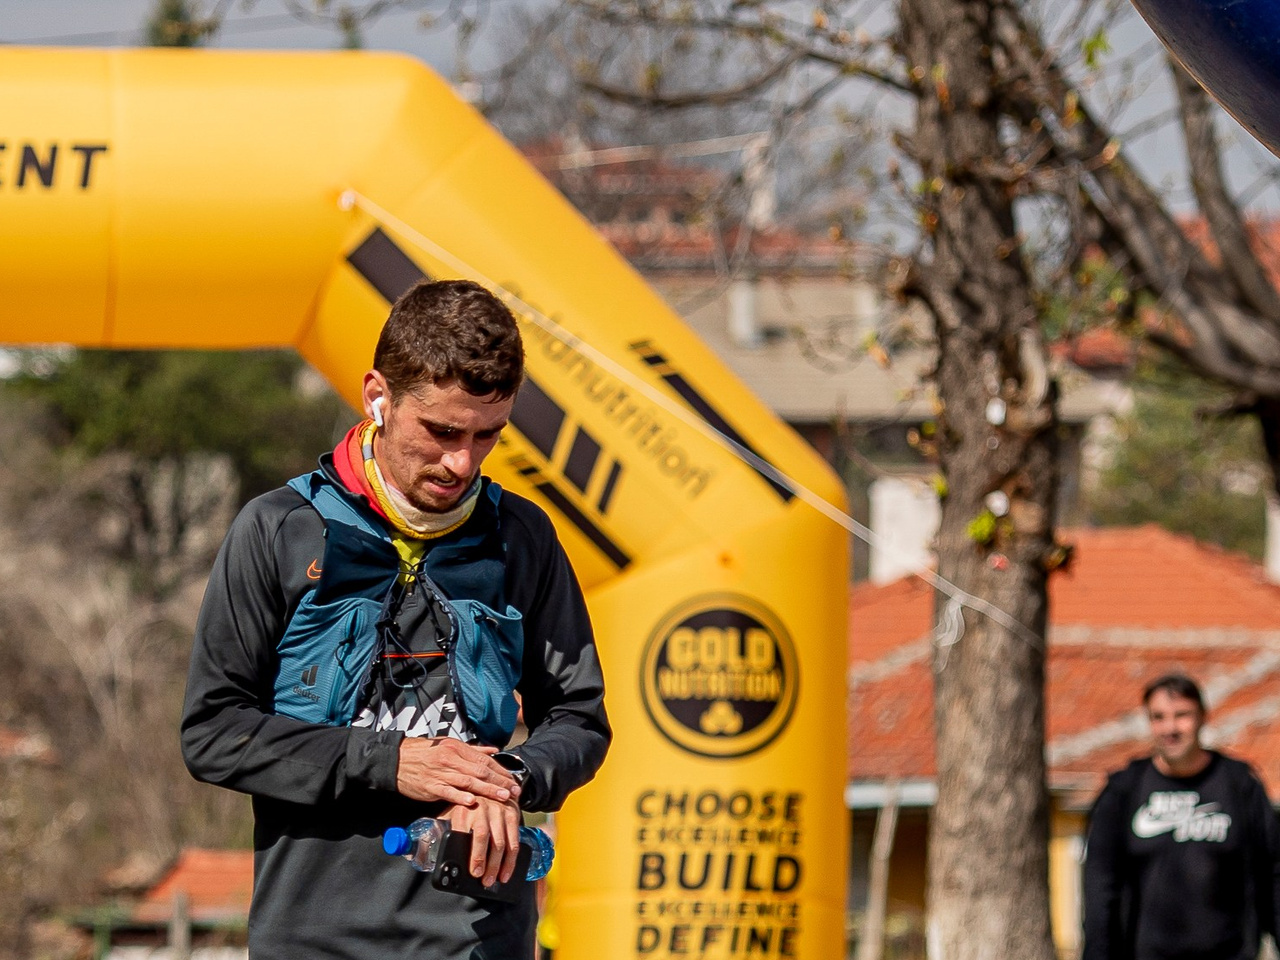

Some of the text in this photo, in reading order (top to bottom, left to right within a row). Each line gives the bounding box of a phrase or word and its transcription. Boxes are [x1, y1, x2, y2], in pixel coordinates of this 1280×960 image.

[667, 626, 775, 672] GOLD
[636, 790, 803, 821] CHOOSE
[637, 852, 801, 892] BUILD
[637, 924, 799, 955] DEFINE
